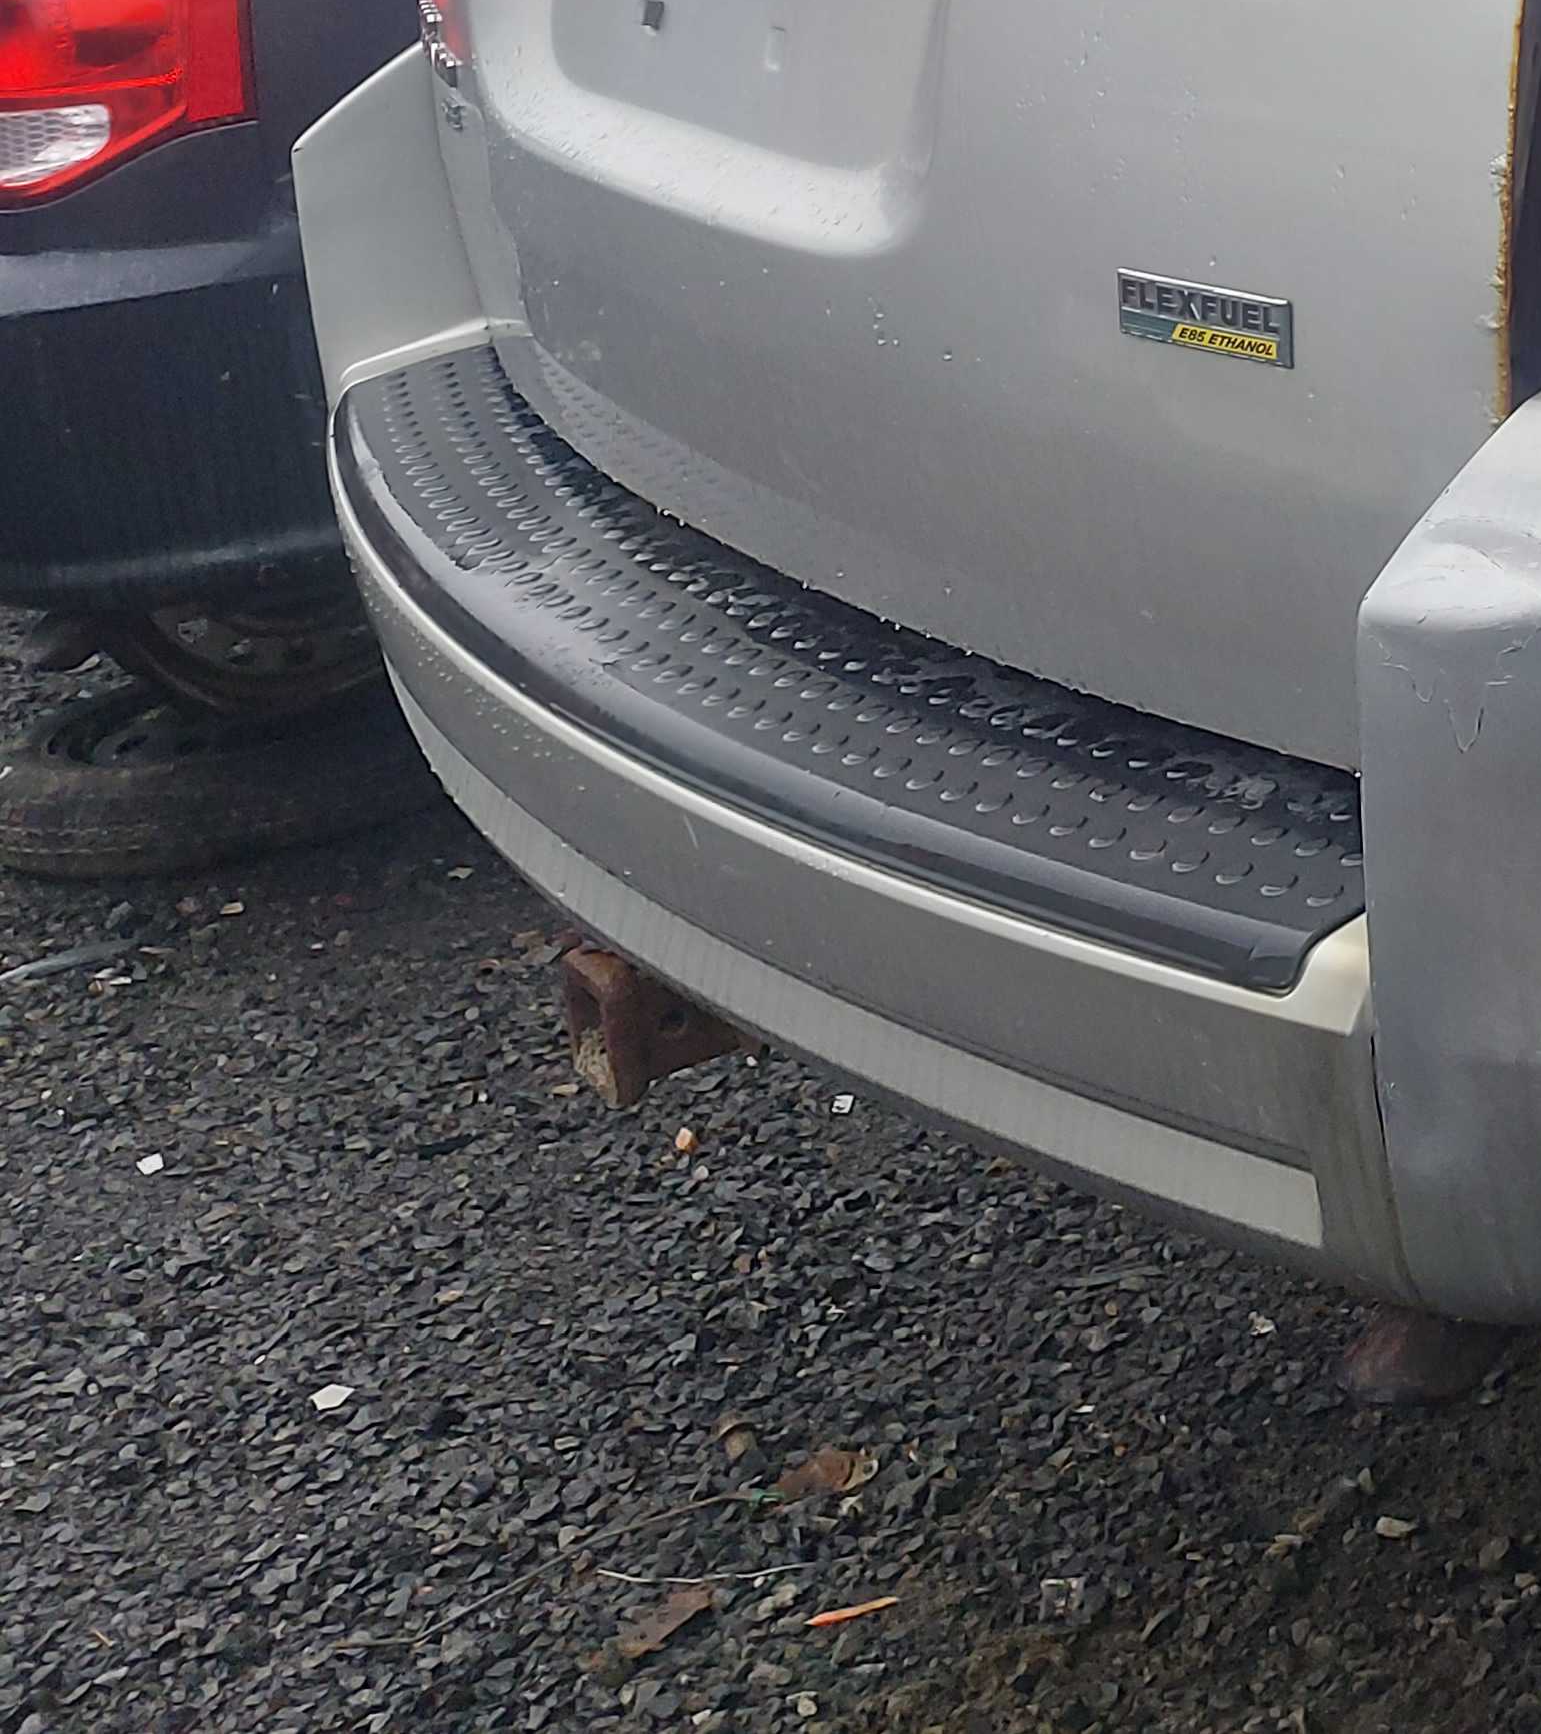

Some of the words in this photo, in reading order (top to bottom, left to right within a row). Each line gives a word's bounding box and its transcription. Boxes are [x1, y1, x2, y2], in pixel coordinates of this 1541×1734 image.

[1121, 277, 1282, 335] FLEXFUEL
[1178, 326, 1205, 344] E85
[1207, 330, 1274, 356] ETHANOL
